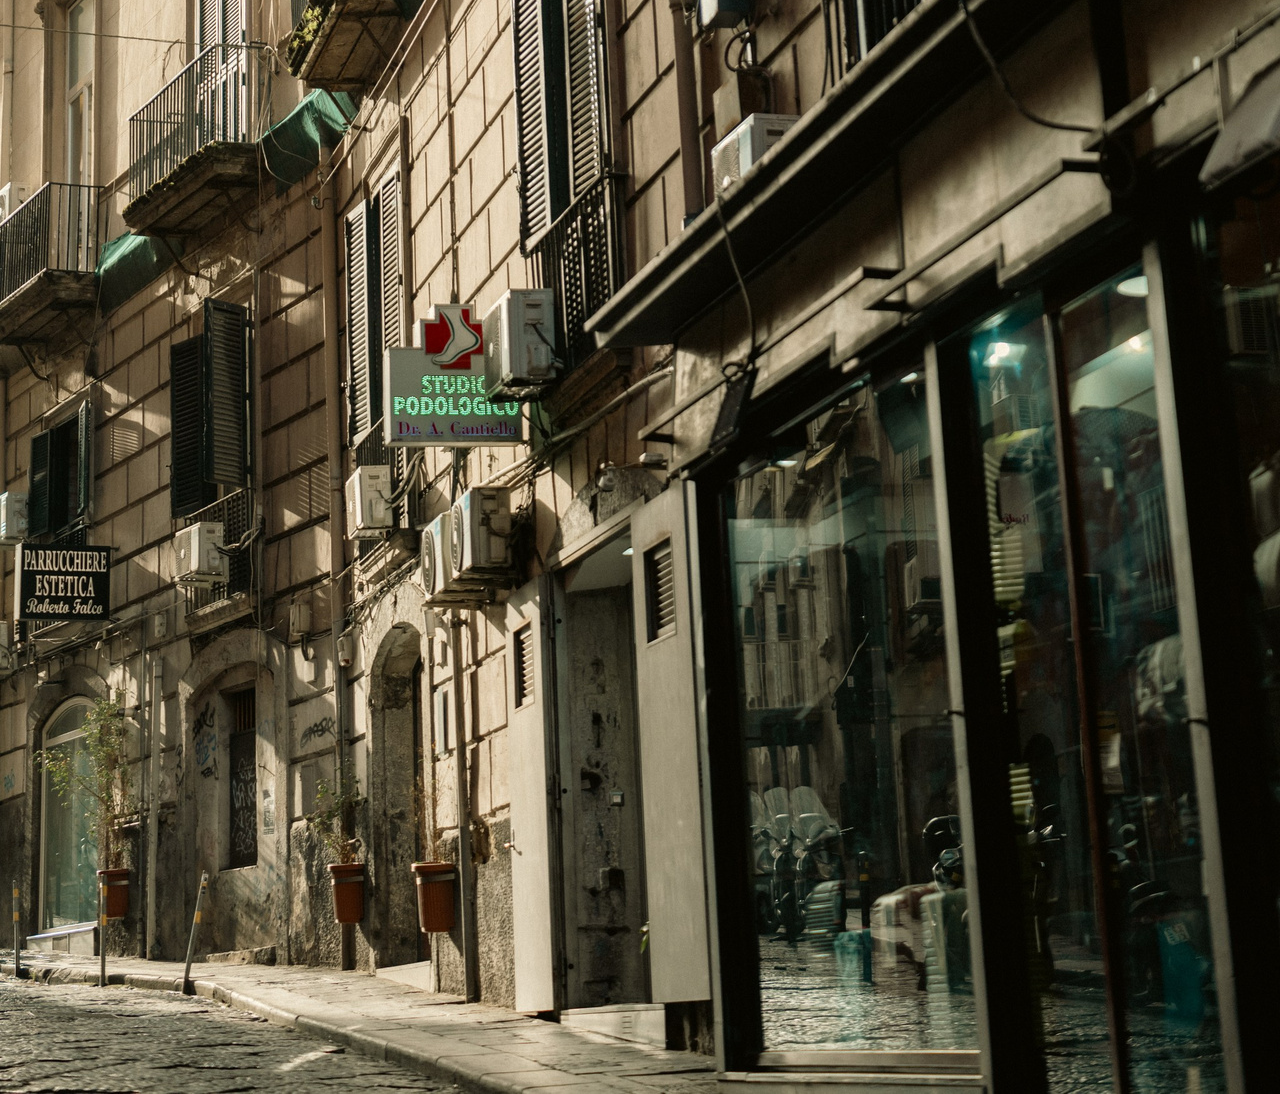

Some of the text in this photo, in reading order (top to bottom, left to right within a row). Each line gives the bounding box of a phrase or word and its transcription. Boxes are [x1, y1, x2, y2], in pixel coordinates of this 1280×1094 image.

[393, 396, 519, 416] PODOLOGICO
[398, 421, 517, 436] Dr. A. Cantiello
[23, 549, 107, 572] PARRUCCHIERE
[35, 575, 95, 597] ESTETICA
[25, 597, 104, 615] Roberto Falco
